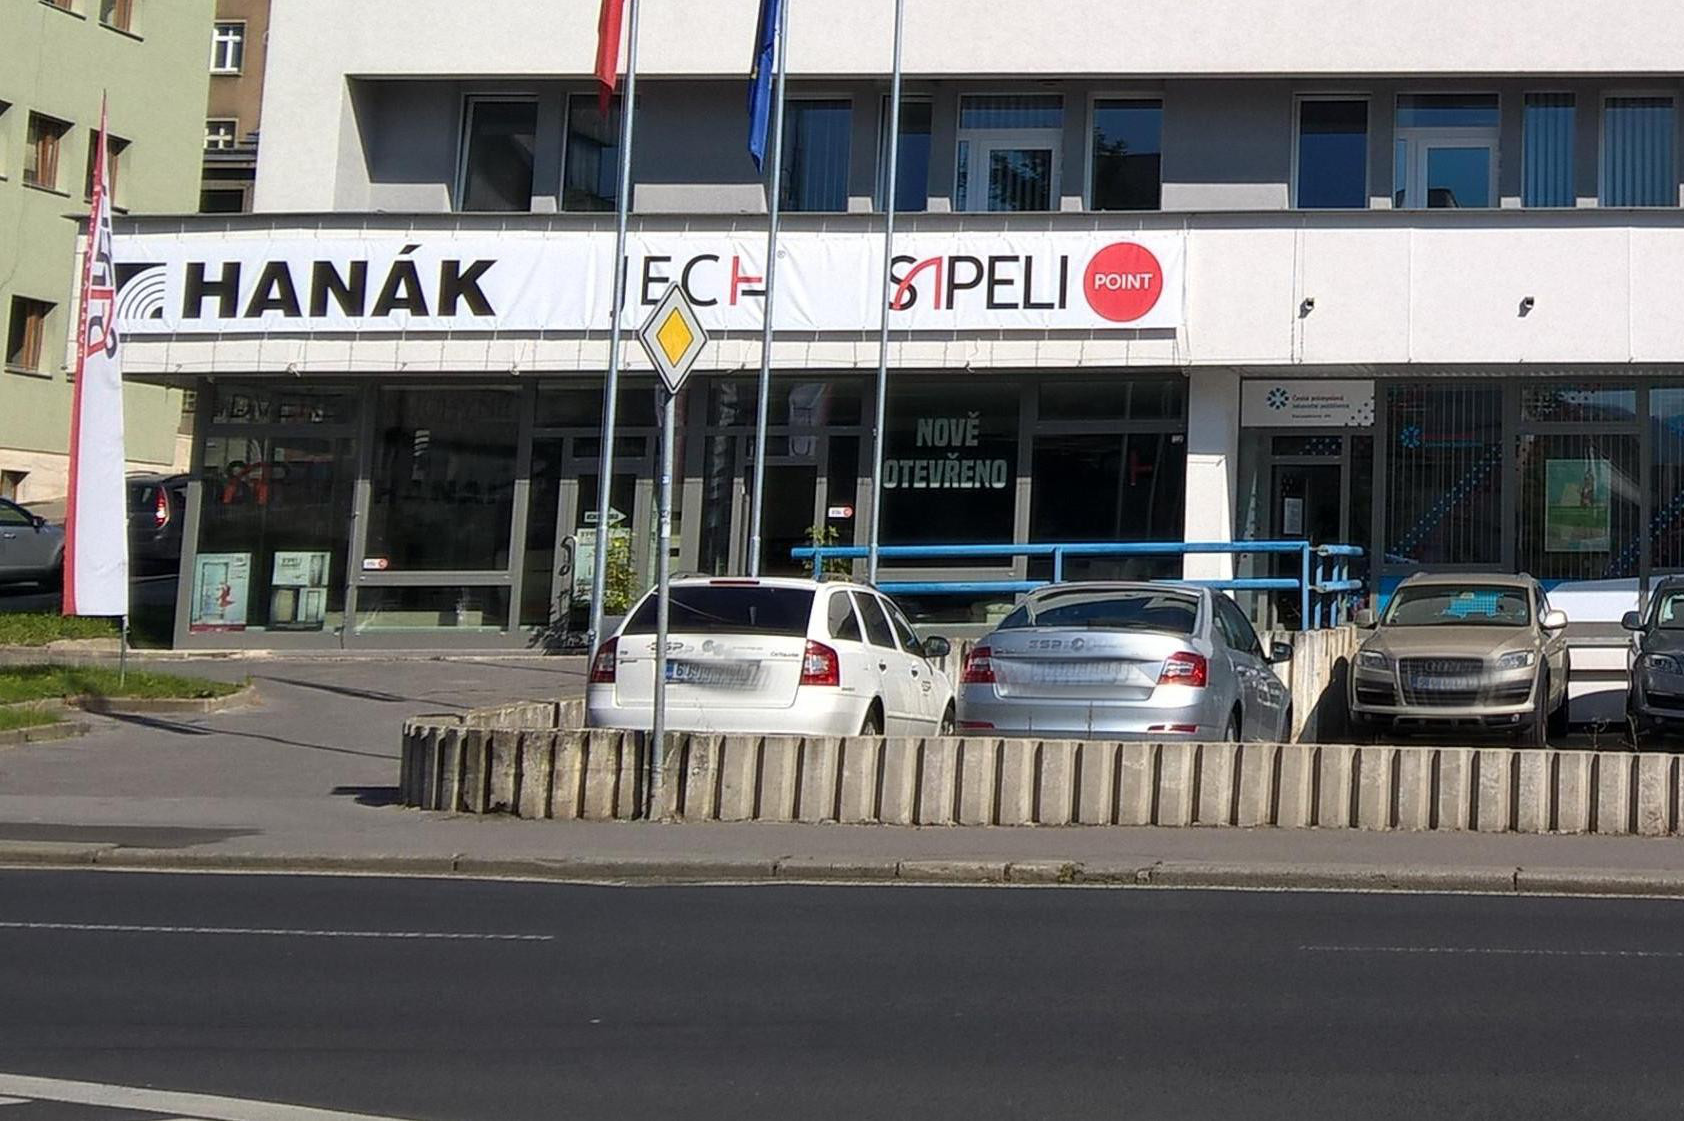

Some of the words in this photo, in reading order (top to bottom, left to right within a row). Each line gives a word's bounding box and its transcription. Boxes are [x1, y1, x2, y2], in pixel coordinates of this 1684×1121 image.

[181, 244, 498, 319] HANÁK
[888, 255, 1069, 311] SAPELI
[1093, 273, 1154, 291] POINT
[916, 411, 980, 447] NOVĚ
[882, 452, 1008, 489] OTEVŘENO
